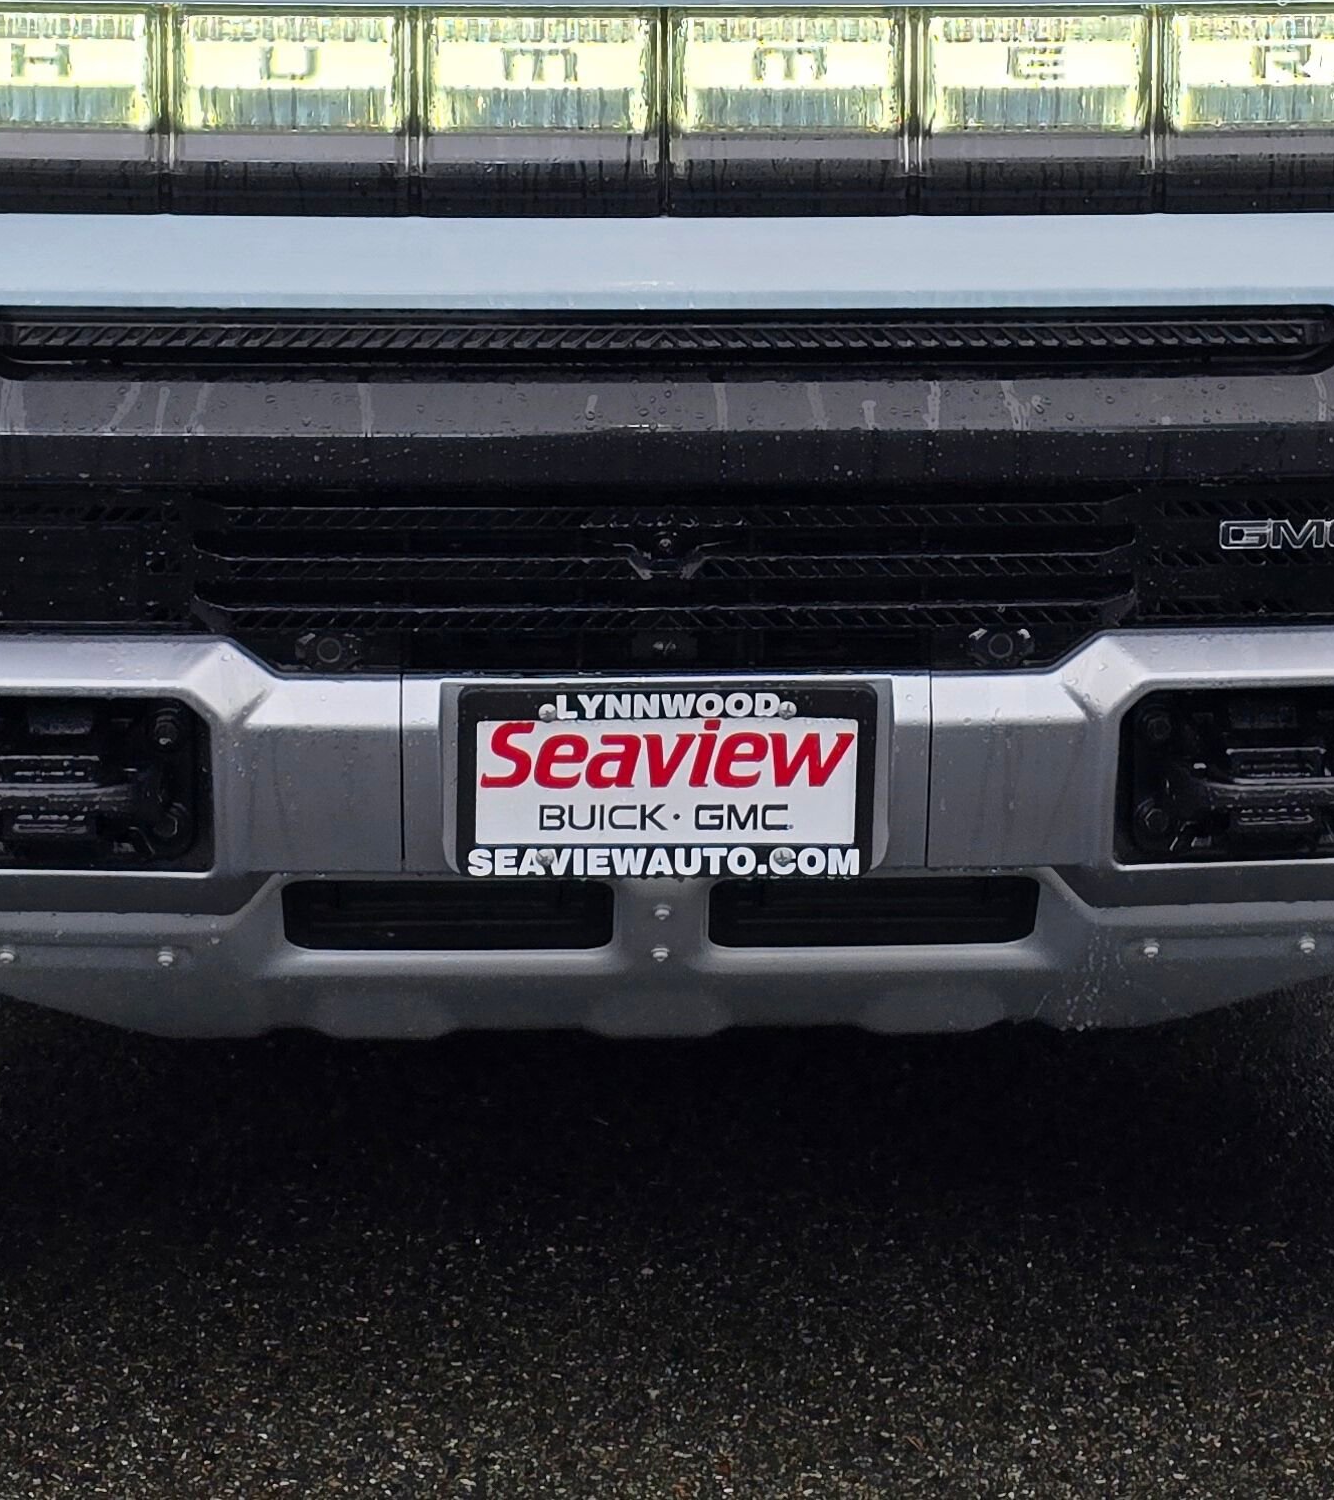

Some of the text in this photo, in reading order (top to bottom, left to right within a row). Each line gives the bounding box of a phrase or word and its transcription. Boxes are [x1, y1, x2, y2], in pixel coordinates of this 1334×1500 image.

[556, 693, 781, 719] LYNNWOOD
[480, 719, 855, 789] Seaview
[539, 804, 790, 830] BUICK GMC
[468, 848, 860, 876] SEAVIEWAUTO.COM
